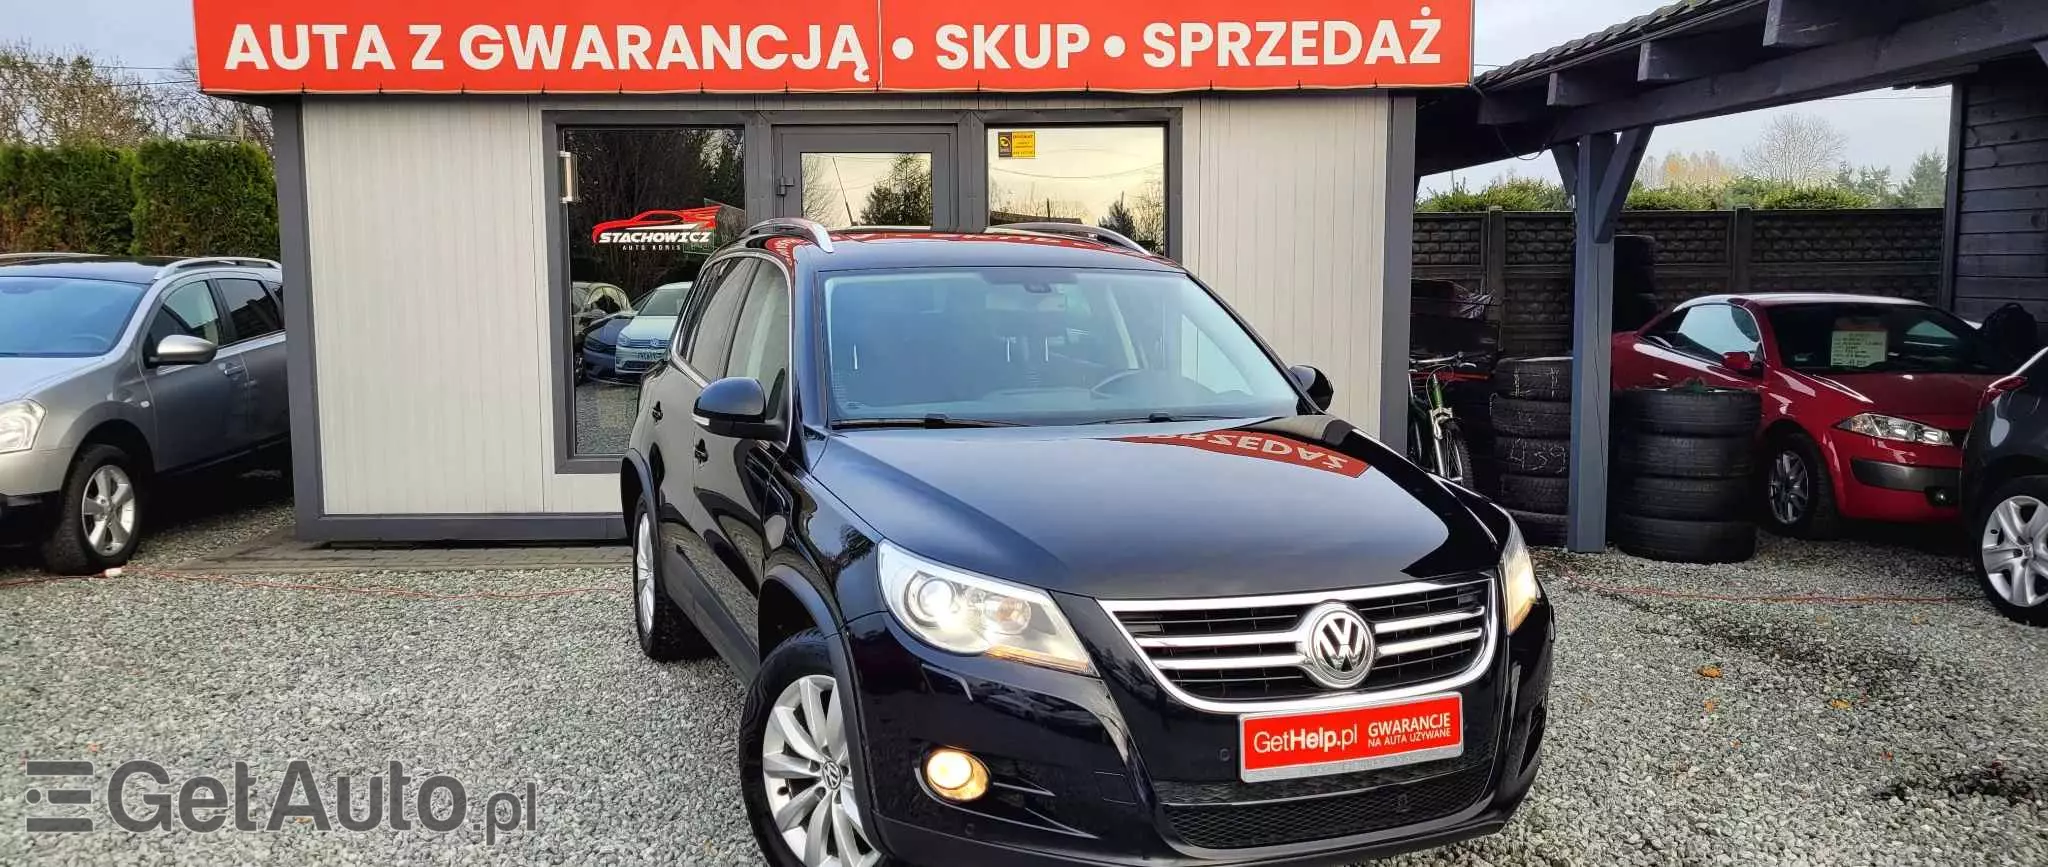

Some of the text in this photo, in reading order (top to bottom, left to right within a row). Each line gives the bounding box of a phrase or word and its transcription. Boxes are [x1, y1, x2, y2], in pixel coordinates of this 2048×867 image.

[225, 7, 1442, 82] AUTA Z GWARANCJĄ SKUP SPRZEDAŻ
[599, 232, 711, 243] STACHOWICZ
[1368, 712, 1450, 737] GWARANCJE
[1254, 724, 1358, 753] GetHelp.pl
[1368, 727, 1451, 748] NA AUTA UŻYWANE
